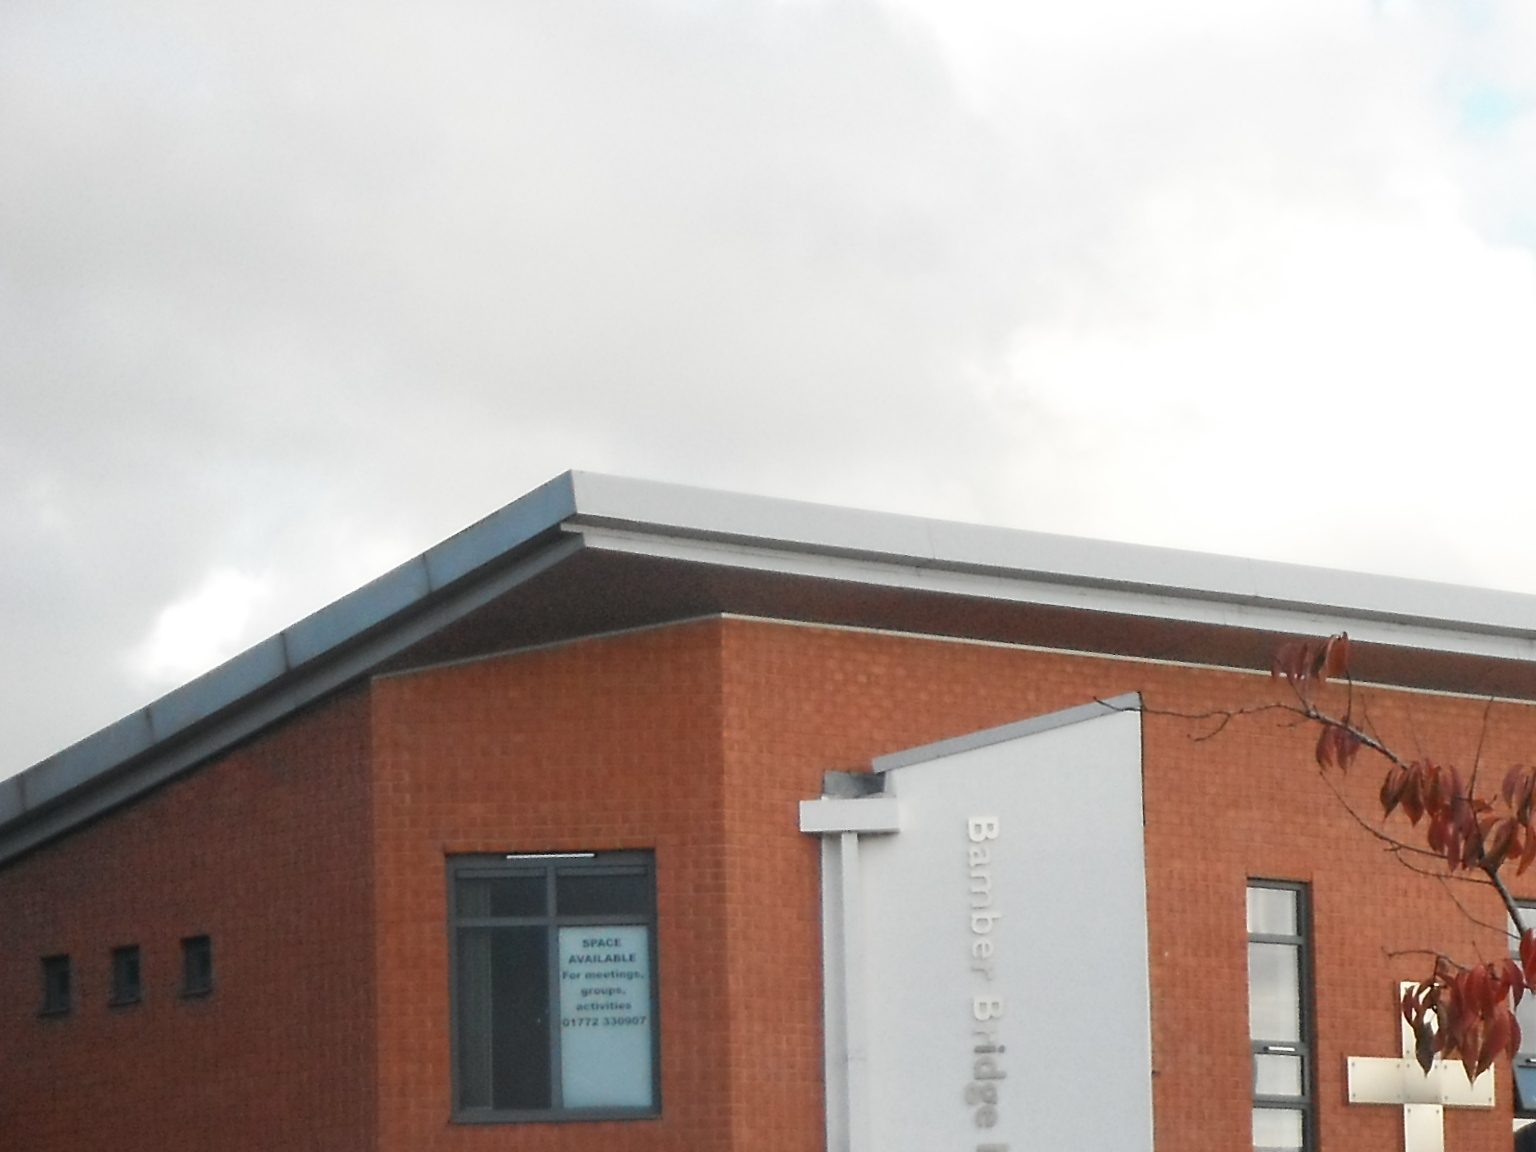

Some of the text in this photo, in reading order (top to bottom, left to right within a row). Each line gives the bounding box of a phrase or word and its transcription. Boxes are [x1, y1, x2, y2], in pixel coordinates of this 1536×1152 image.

[966, 815, 1001, 980] Bamber
[582, 938, 622, 948] SPACE
[568, 953, 637, 963] AVAILABLE
[562, 971, 581, 979] For
[576, 1002, 632, 1012] activities
[562, 1017, 599, 1027] 01772
[964, 995, 1006, 1129] Bridge
